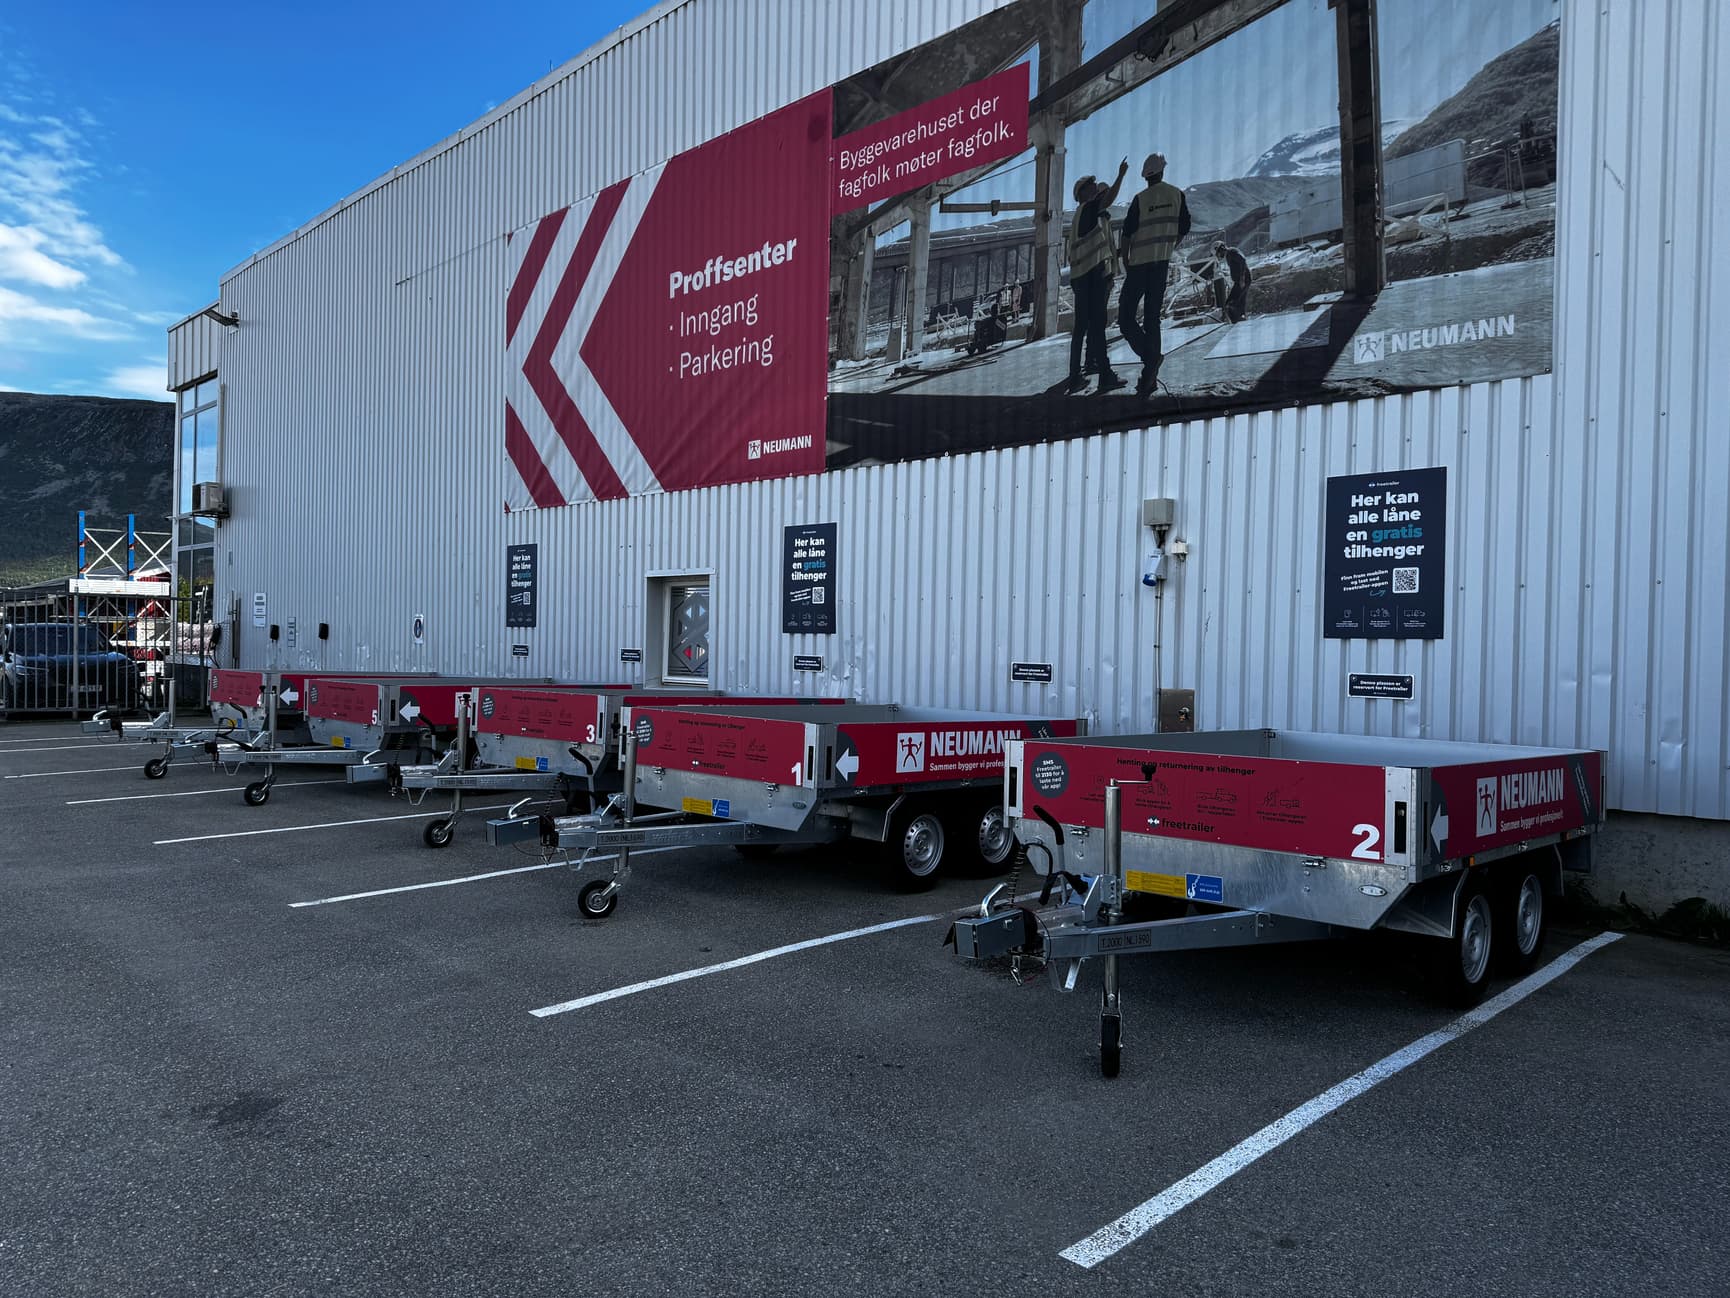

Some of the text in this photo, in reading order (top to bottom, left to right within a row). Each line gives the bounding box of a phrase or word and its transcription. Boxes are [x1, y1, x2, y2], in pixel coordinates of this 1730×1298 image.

[840, 96, 999, 171] Byggevarehuset der
[839, 120, 1014, 197] fagfolk møter fagfolk.
[669, 238, 797, 299] Proffsenter
[680, 294, 758, 337] Inngang
[1391, 314, 1515, 353] NEUMANN
[680, 334, 774, 379] Parkering
[763, 435, 812, 455] NEUMANN
[1351, 491, 1420, 508] Her kan
[1348, 506, 1422, 525] alle låne
[794, 537, 825, 547] Her kan
[1346, 524, 1424, 544] en gratis
[793, 547, 826, 559] alle låne
[1343, 544, 1425, 560] tilhenger
[803, 559, 826, 571] gratis
[791, 571, 828, 582] tilhenger
[371, 709, 378, 725] 5
[586, 724, 595, 743] 3
[791, 761, 801, 786] 1
[929, 761, 957, 773] Sammen
[957, 760, 979, 773] bygger
[979, 760, 985, 769] vi
[1501, 768, 1564, 811] NEUMANN
[1161, 818, 1215, 833] freetrailer
[1351, 823, 1380, 860] 2
